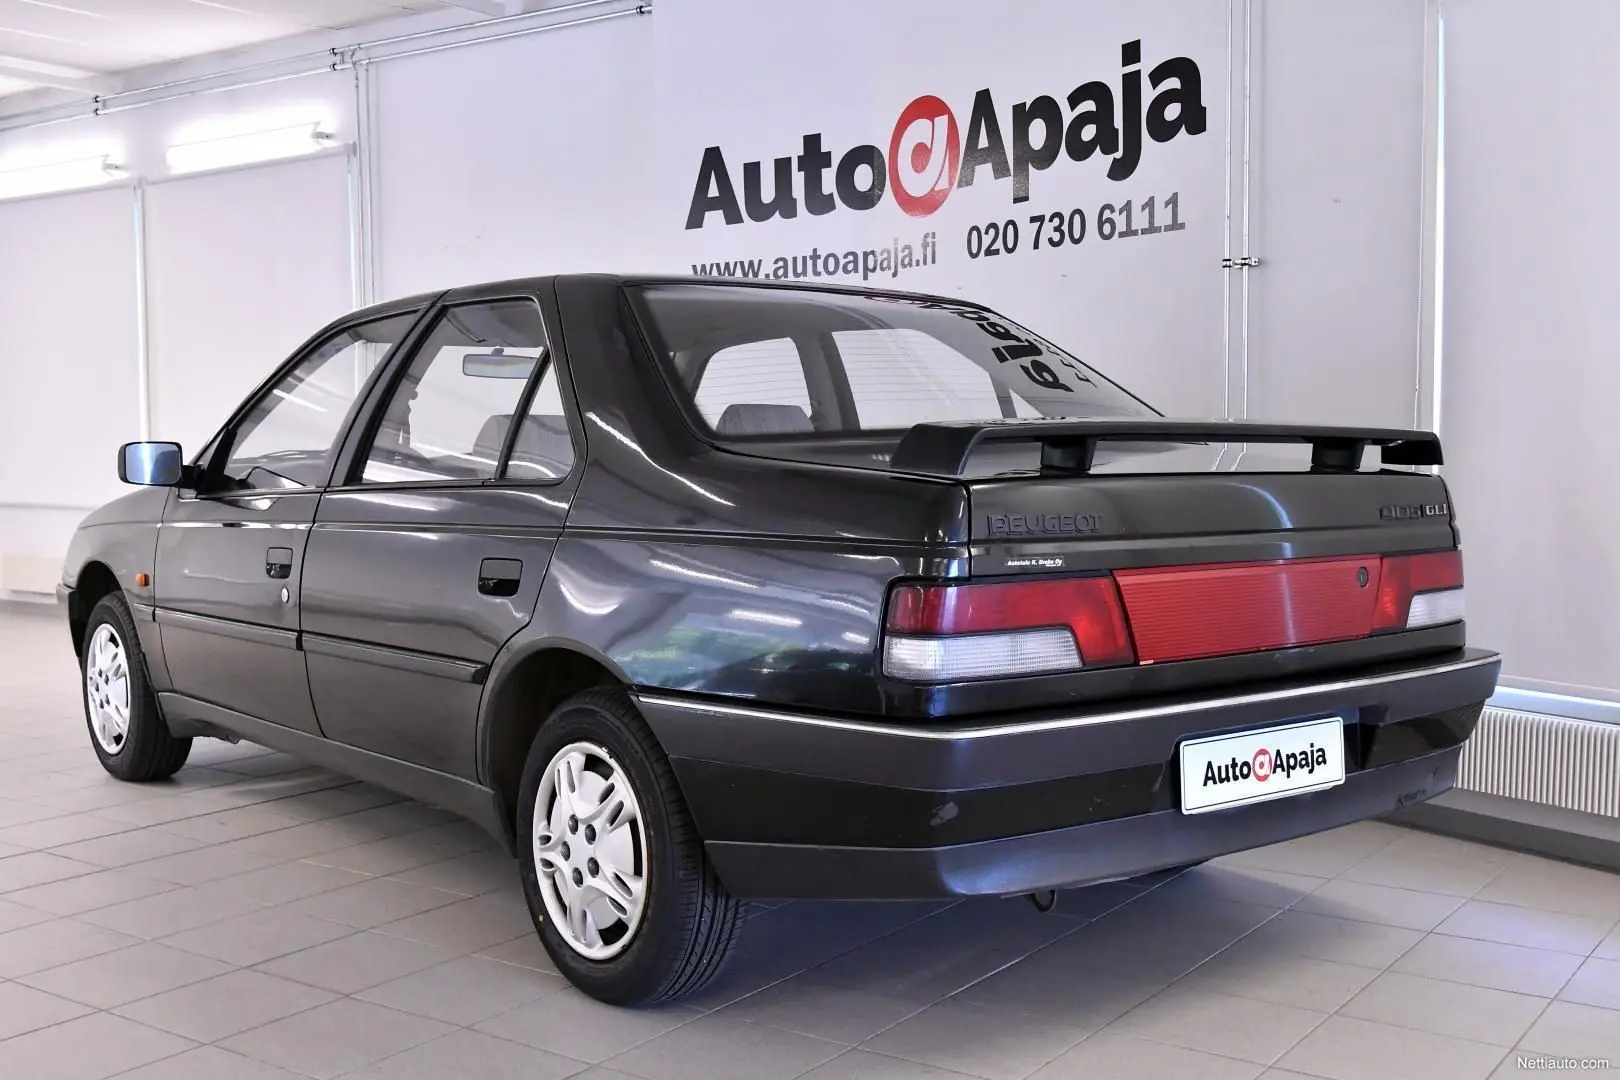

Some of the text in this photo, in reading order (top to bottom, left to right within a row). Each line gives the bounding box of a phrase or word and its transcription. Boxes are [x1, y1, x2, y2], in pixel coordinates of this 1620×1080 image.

[957, 39, 1206, 203] Apaja
[967, 191, 1185, 259] 020 730 6111
[692, 232, 936, 281] www.autoapaja.fi
[987, 514, 1101, 536] PEUGEOT
[1272, 743, 1327, 778] Apaja
